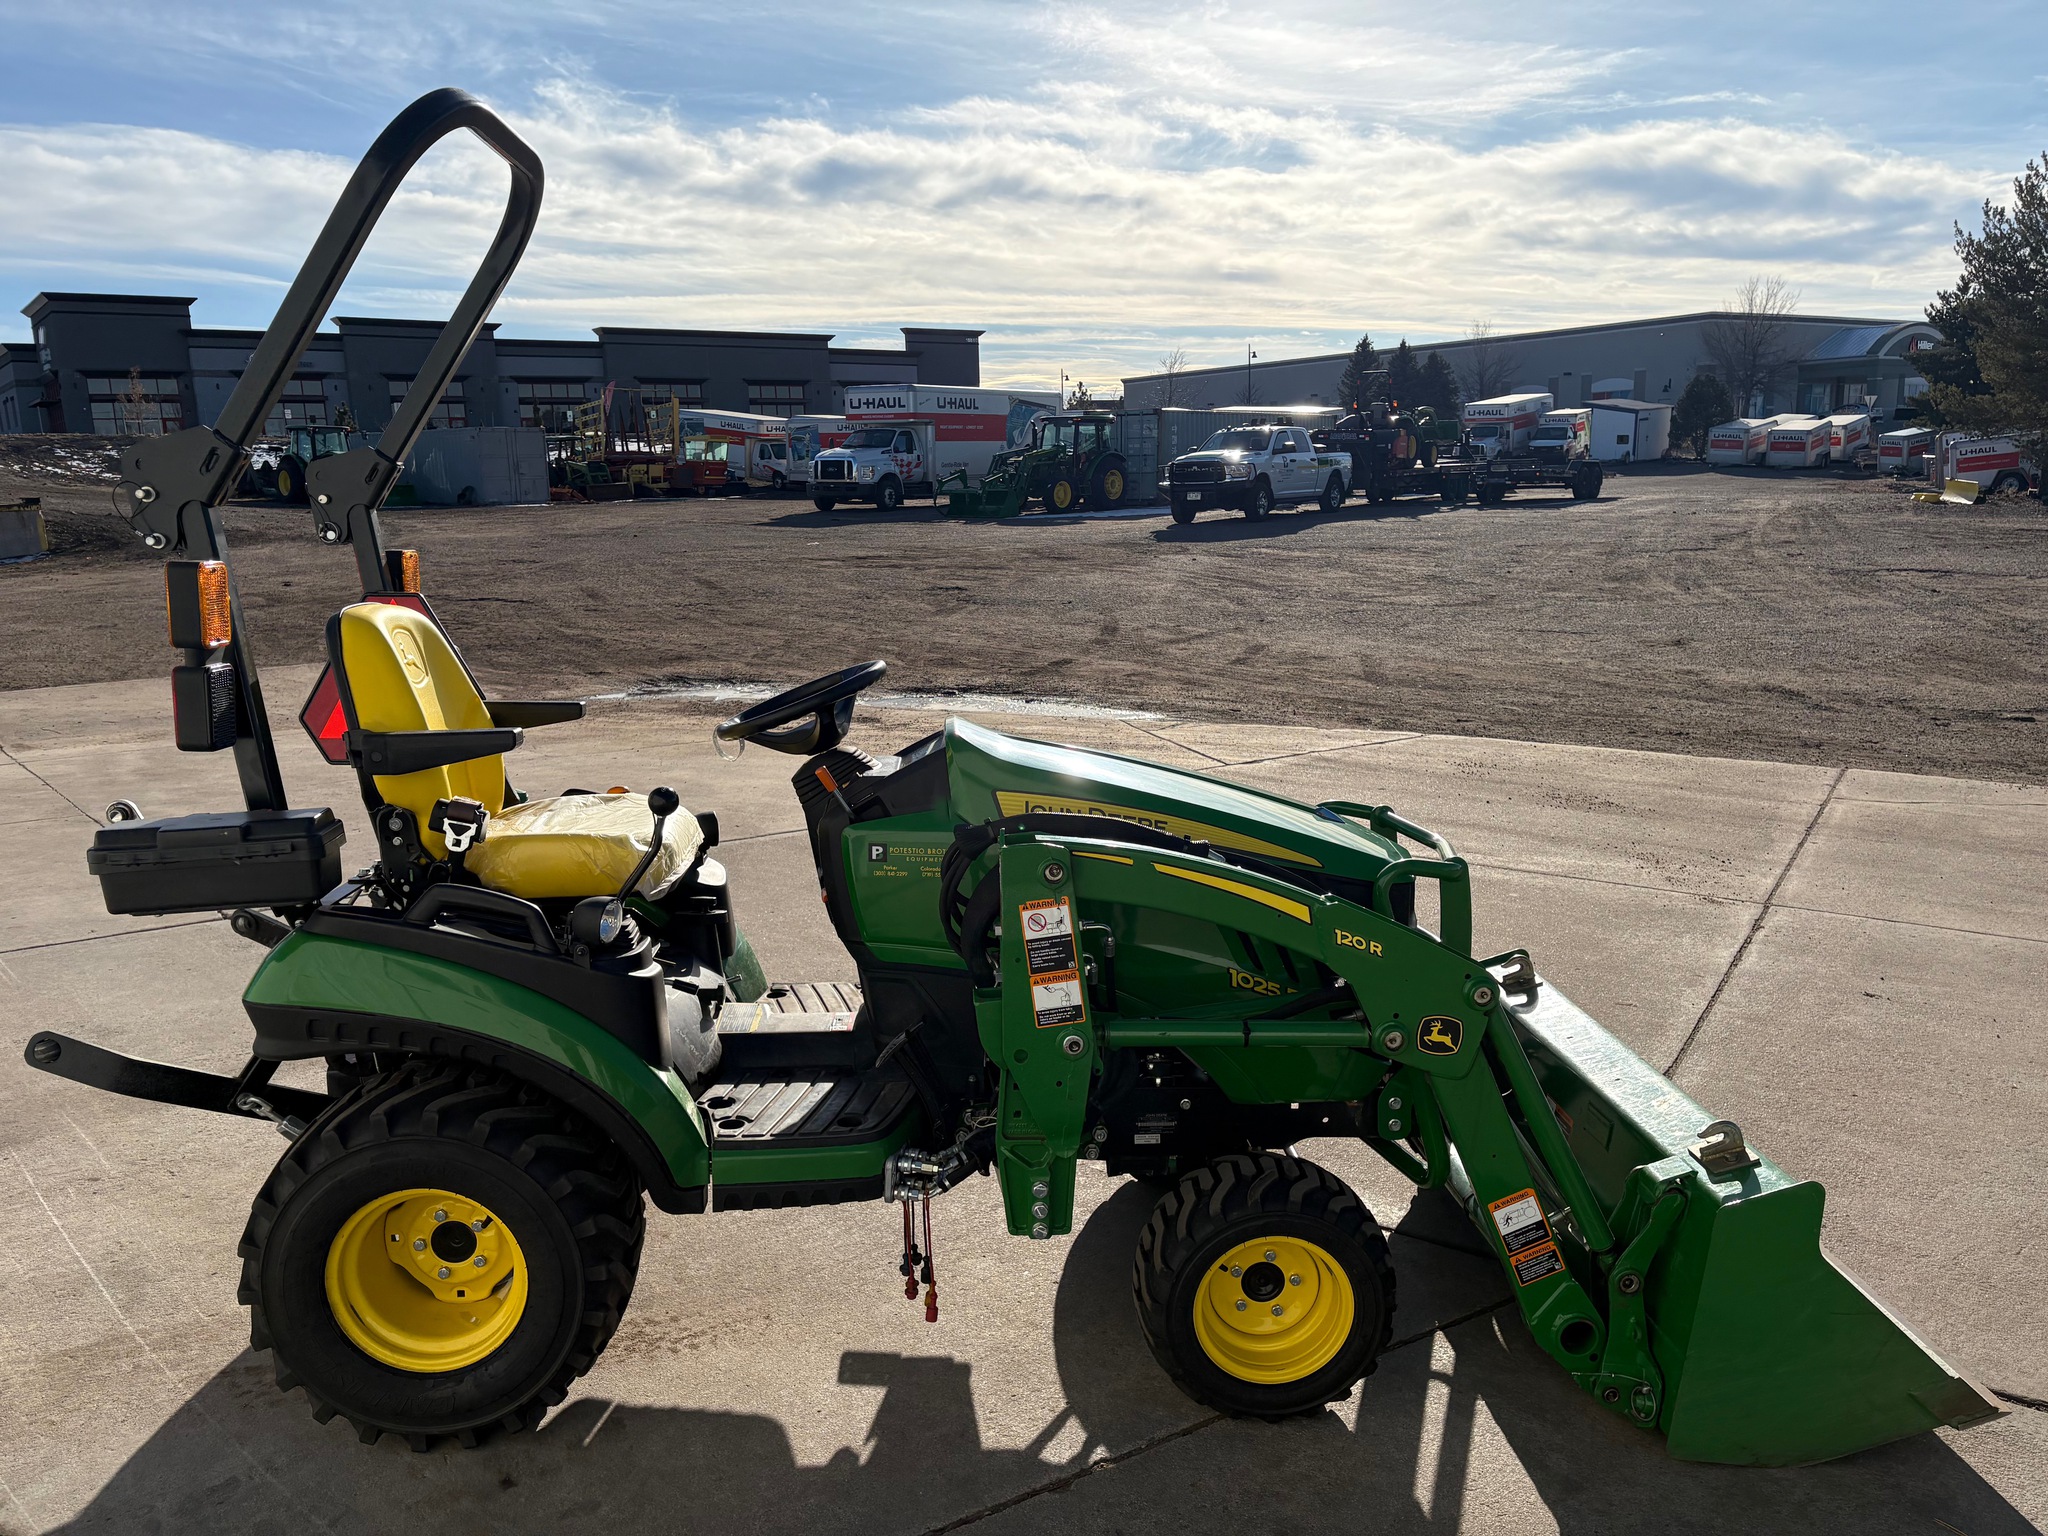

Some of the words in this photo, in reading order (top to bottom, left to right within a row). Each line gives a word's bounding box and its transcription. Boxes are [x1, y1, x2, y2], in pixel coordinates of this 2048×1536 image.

[1917, 340, 1934, 350] Hiller
[850, 397, 906, 409] U-HAUL
[936, 396, 979, 410] U-HAUL
[1467, 409, 1504, 417] U-HAUL
[720, 420, 745, 431] U-HAUL
[766, 425, 787, 433] U-HA
[1959, 446, 1997, 456] U-HAUL
[1028, 897, 1066, 909] WARNIG
[1335, 928, 1366, 949] 120
[1369, 940, 1383, 957] R
[1040, 972, 1077, 984] WARNING
[1229, 968, 1280, 995] 1025
[1501, 1191, 1529, 1206] WARNING
[1522, 1246, 1551, 1260] WARNING
